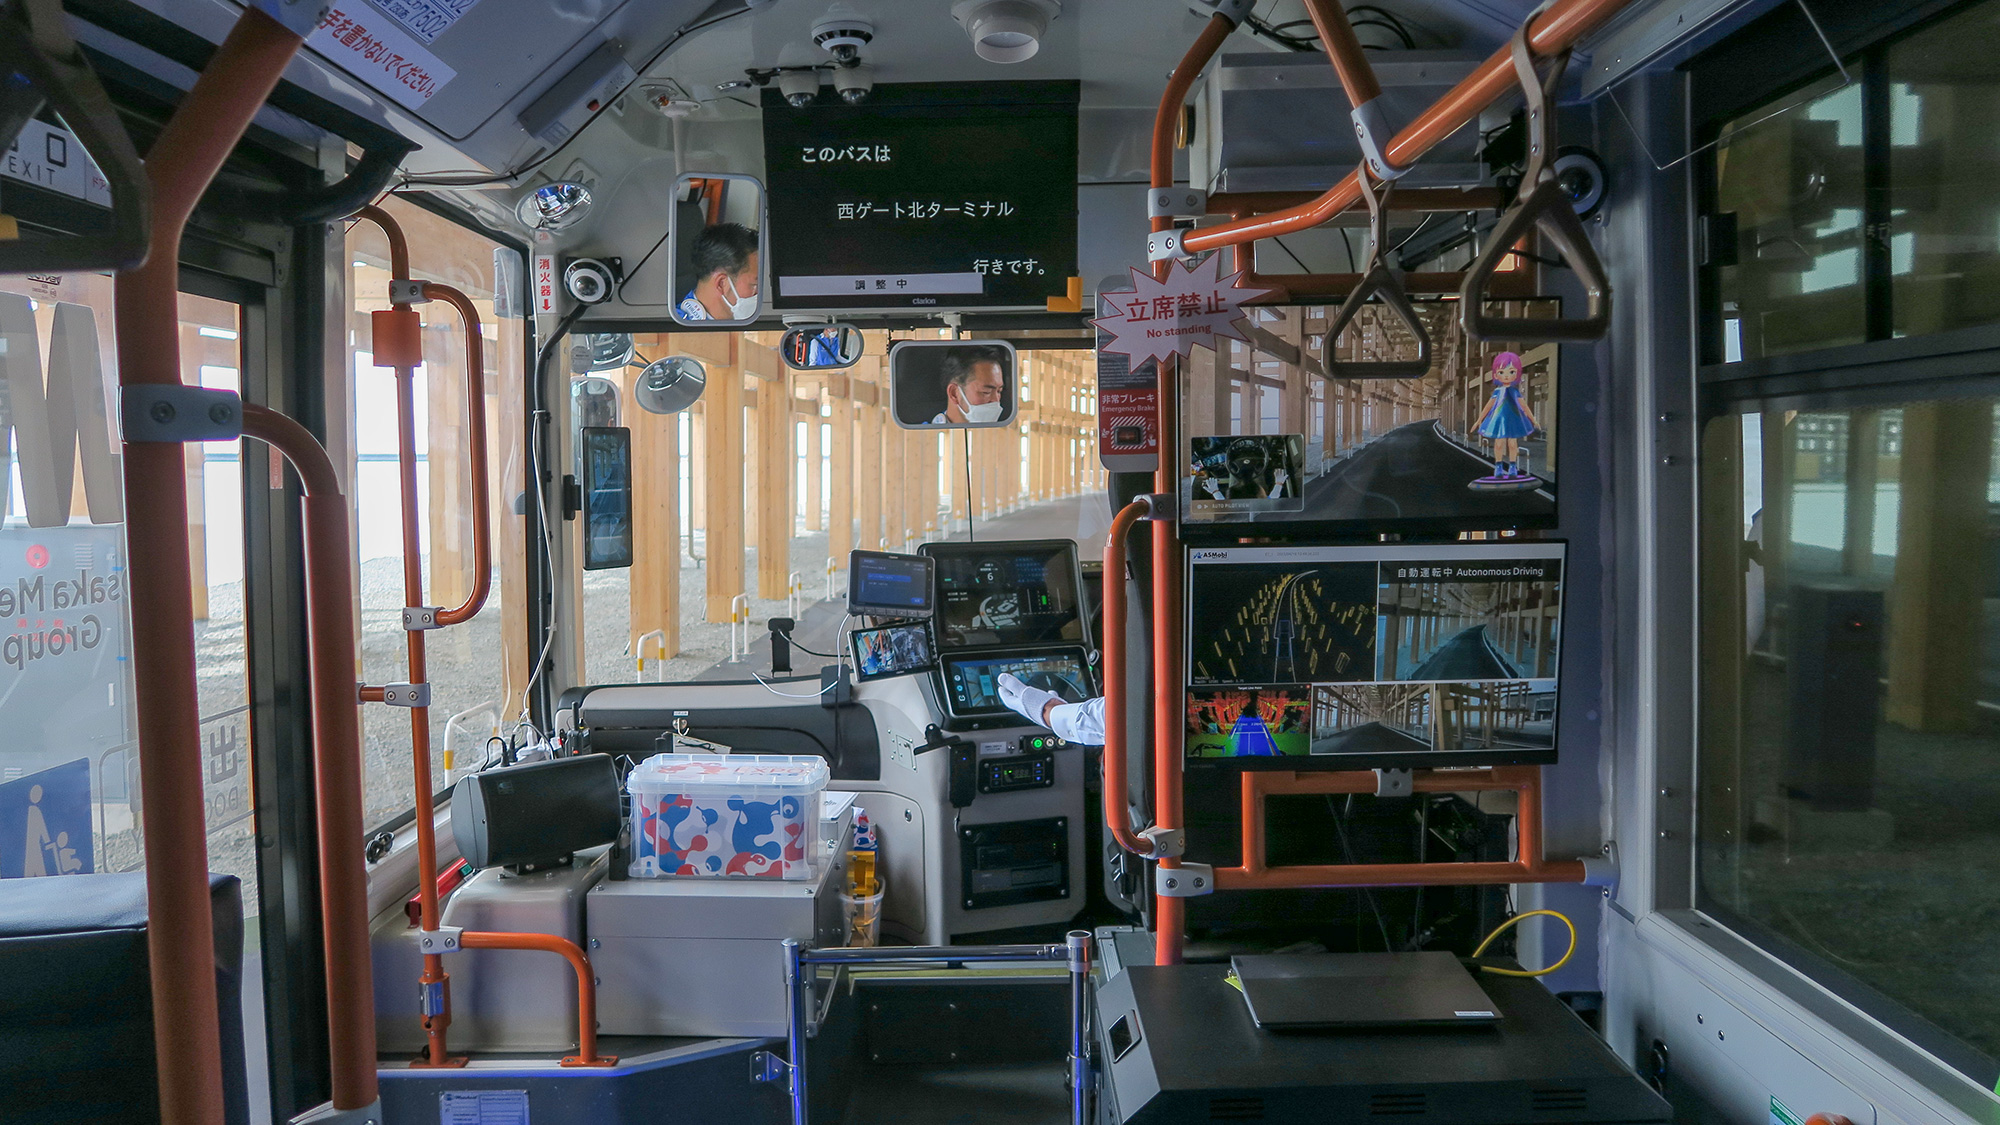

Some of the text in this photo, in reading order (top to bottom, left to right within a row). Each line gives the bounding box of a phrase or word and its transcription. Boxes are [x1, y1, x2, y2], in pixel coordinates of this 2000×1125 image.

[408, 4, 448, 38] 7502
[318, 9, 436, 99] 手を置かないでください。
[801, 145, 892, 163] このバスは
[8, 155, 56, 186] EXIT
[837, 200, 1015, 220] 西ゲート北ターミナル
[972, 258, 1046, 276] 行きです。
[539, 258, 551, 296] 消火器
[854, 278, 909, 290] 調整中
[1126, 290, 1229, 323] 立席禁止
[1146, 323, 1212, 339] No standing
[1101, 393, 1155, 404] 非常ブレーキ
[1101, 404, 1156, 413] Emergency Brake
[987, 572, 994, 581] 6
[1397, 566, 1544, 578] 自動運転中 Autonomous Driving
